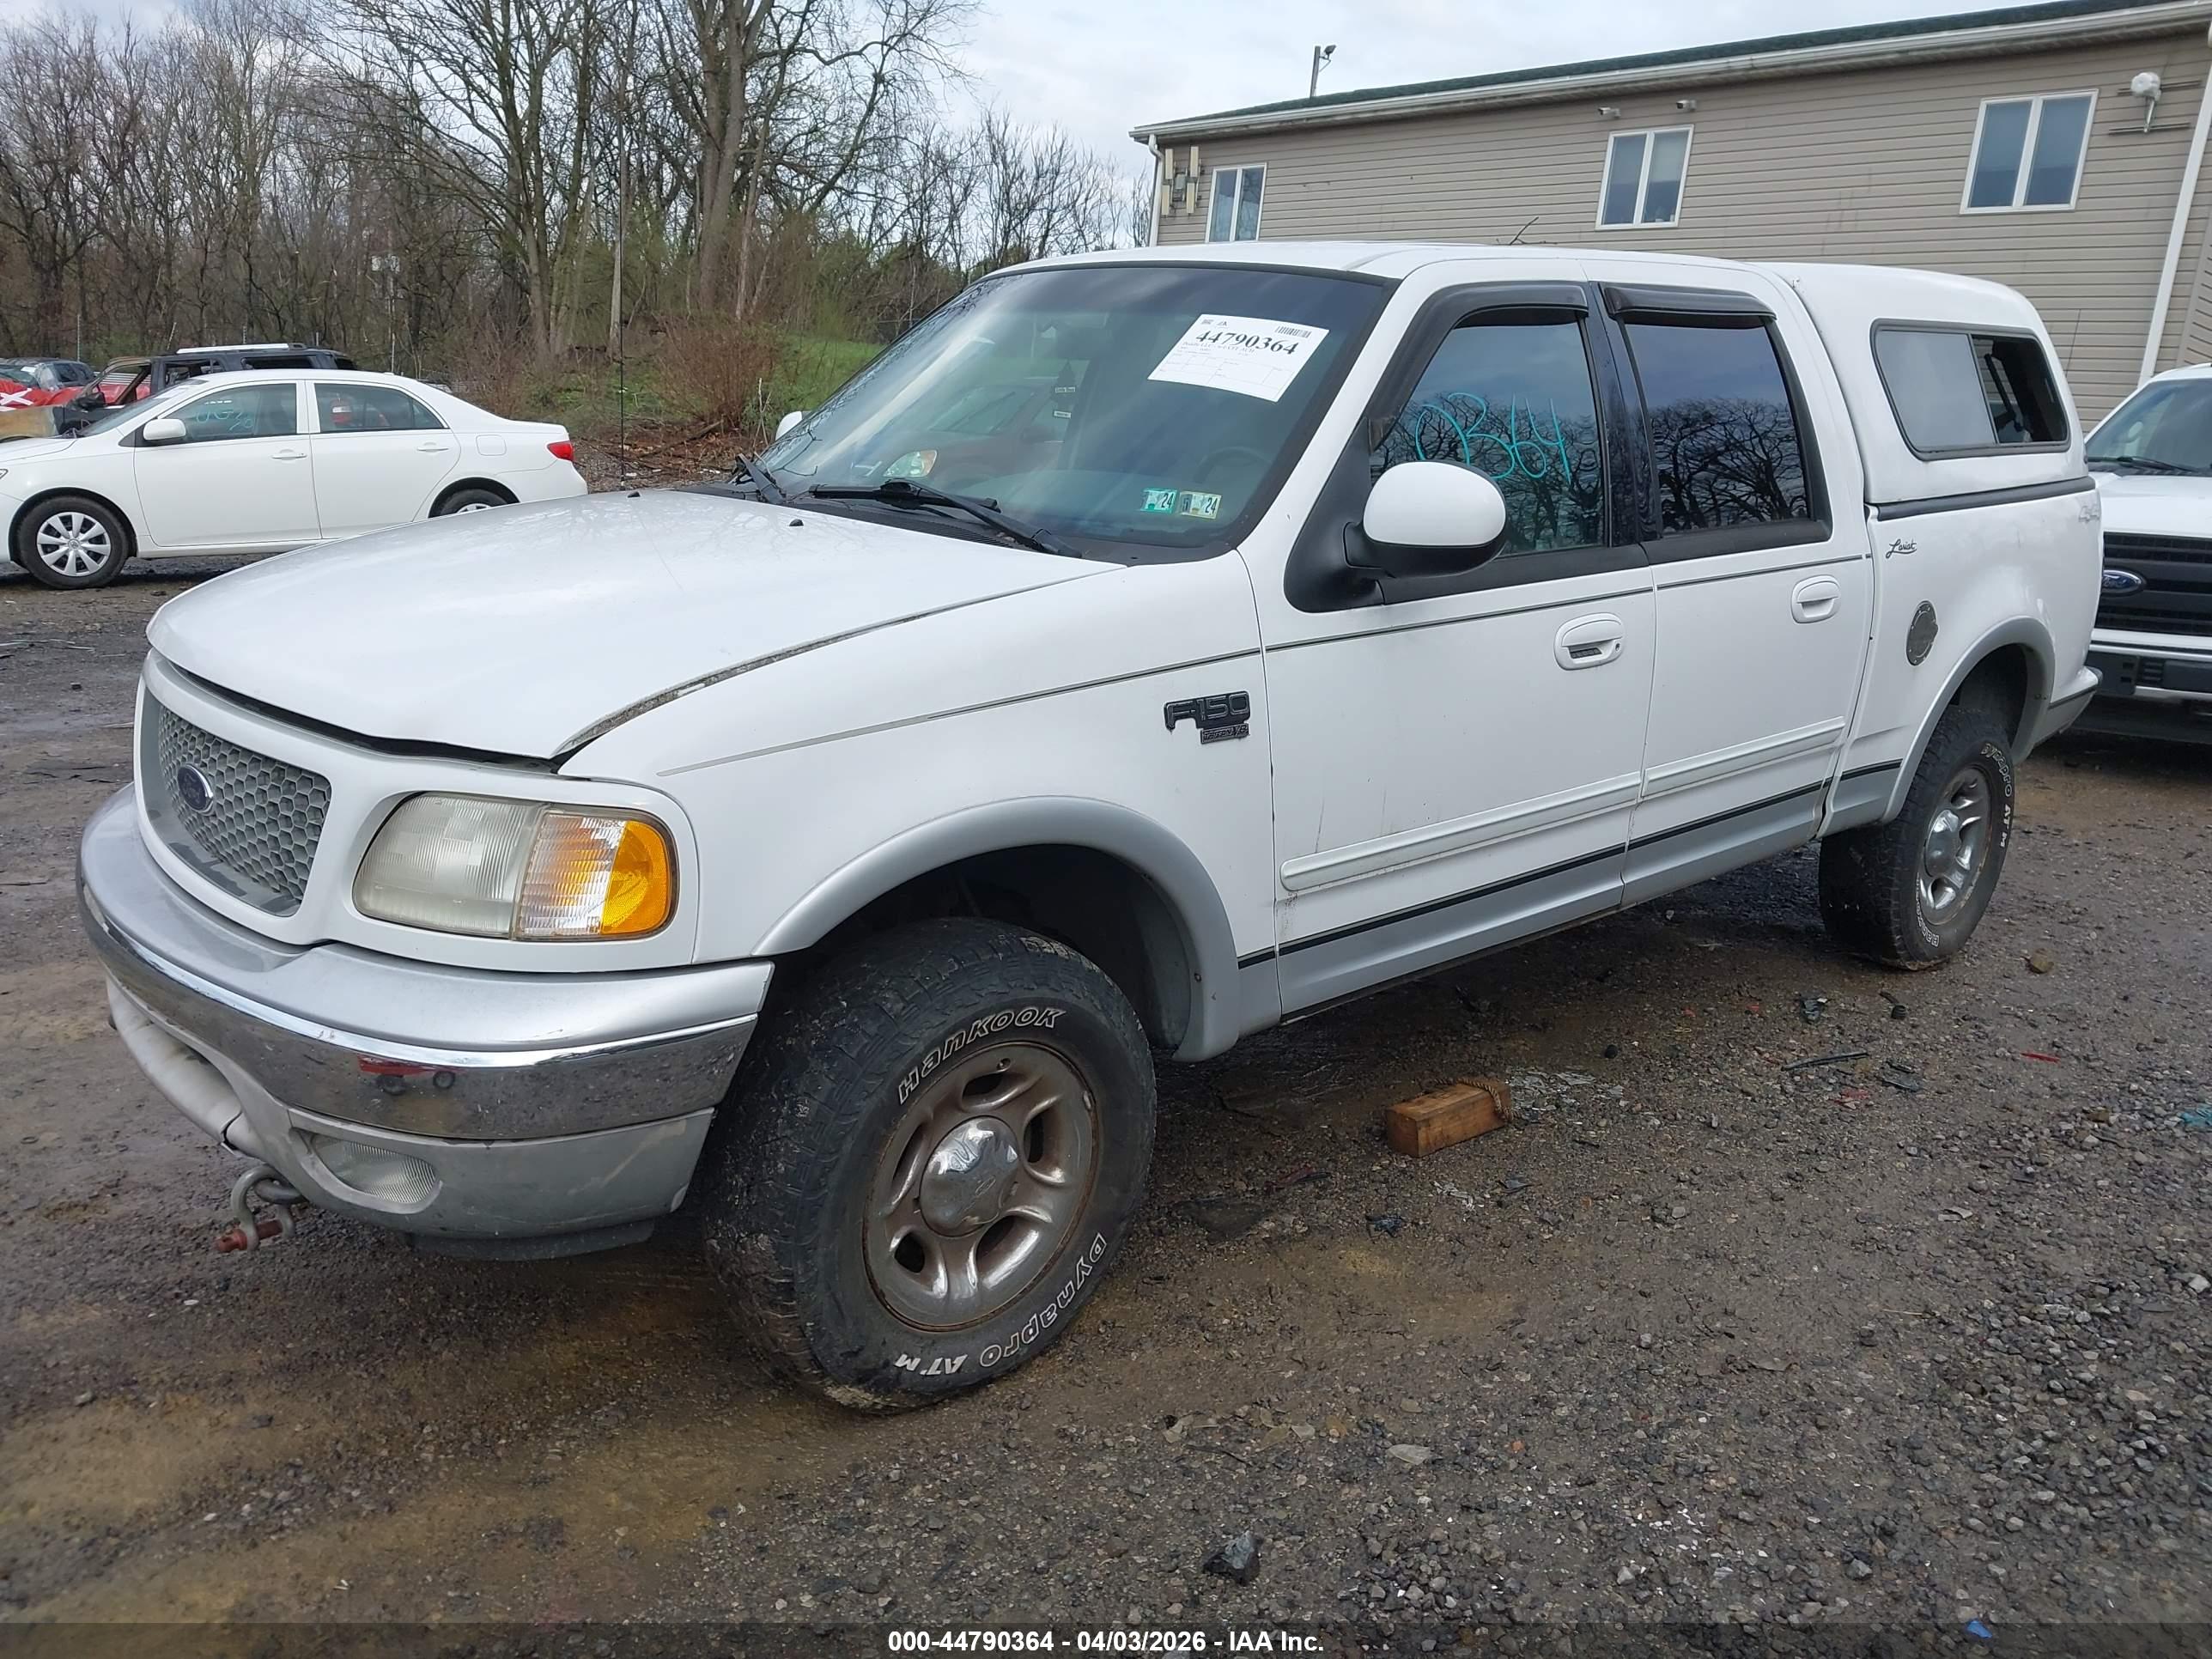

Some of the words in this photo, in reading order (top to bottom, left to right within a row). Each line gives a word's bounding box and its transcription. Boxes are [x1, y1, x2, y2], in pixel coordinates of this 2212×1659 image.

[1195, 330, 1300, 356] 44790364
[1161, 492, 1175, 508] 24
[1205, 497, 1218, 514] 24
[1885, 538, 1917, 559] Lariat
